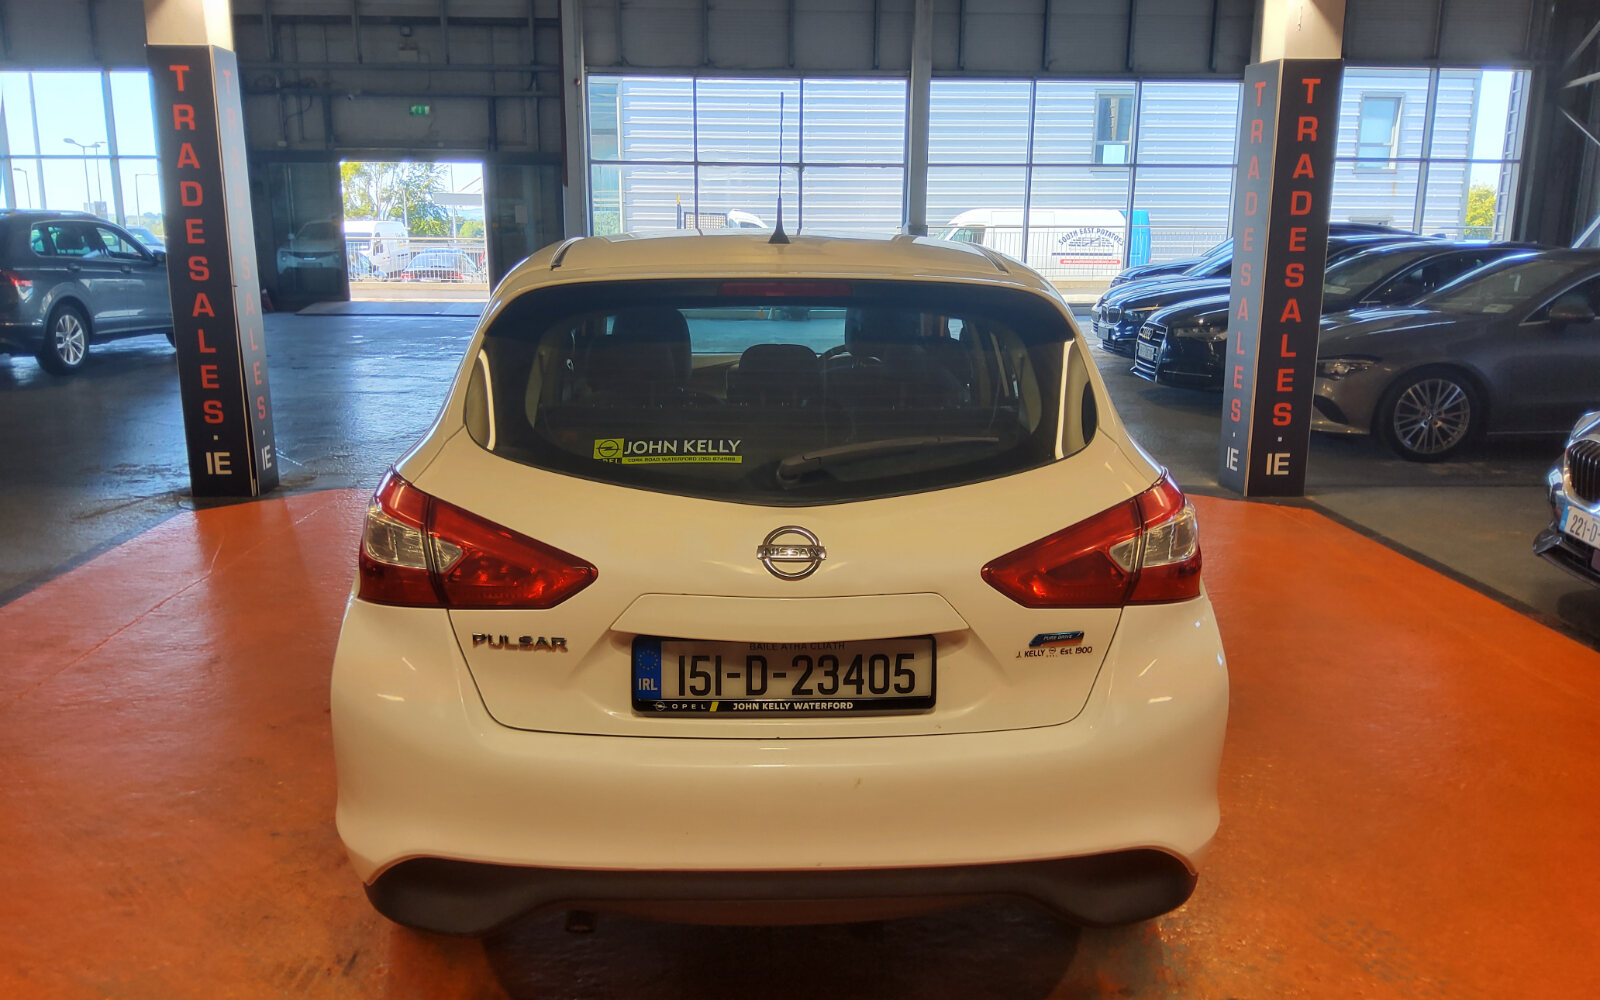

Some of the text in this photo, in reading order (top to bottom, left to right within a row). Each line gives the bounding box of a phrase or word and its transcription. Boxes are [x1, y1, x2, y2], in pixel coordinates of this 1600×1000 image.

[1058, 229, 1079, 246] SOUTH
[1079, 227, 1095, 235] EAST
[624, 439, 741, 455] JOHN KELLY
[763, 546, 822, 558] NISSAN
[472, 633, 568, 652] PULSAR
[750, 643, 777, 651] BAILE
[810, 642, 845, 650] CLIATH
[1024, 649, 1046, 658] KELLY
[1075, 646, 1093, 655] 1900
[678, 653, 915, 696] 151-D-23405
[638, 678, 658, 691] IRL
[733, 702, 759, 710] JOHN
[762, 702, 791, 710] KELLY
[793, 702, 854, 710] WATERFORD
